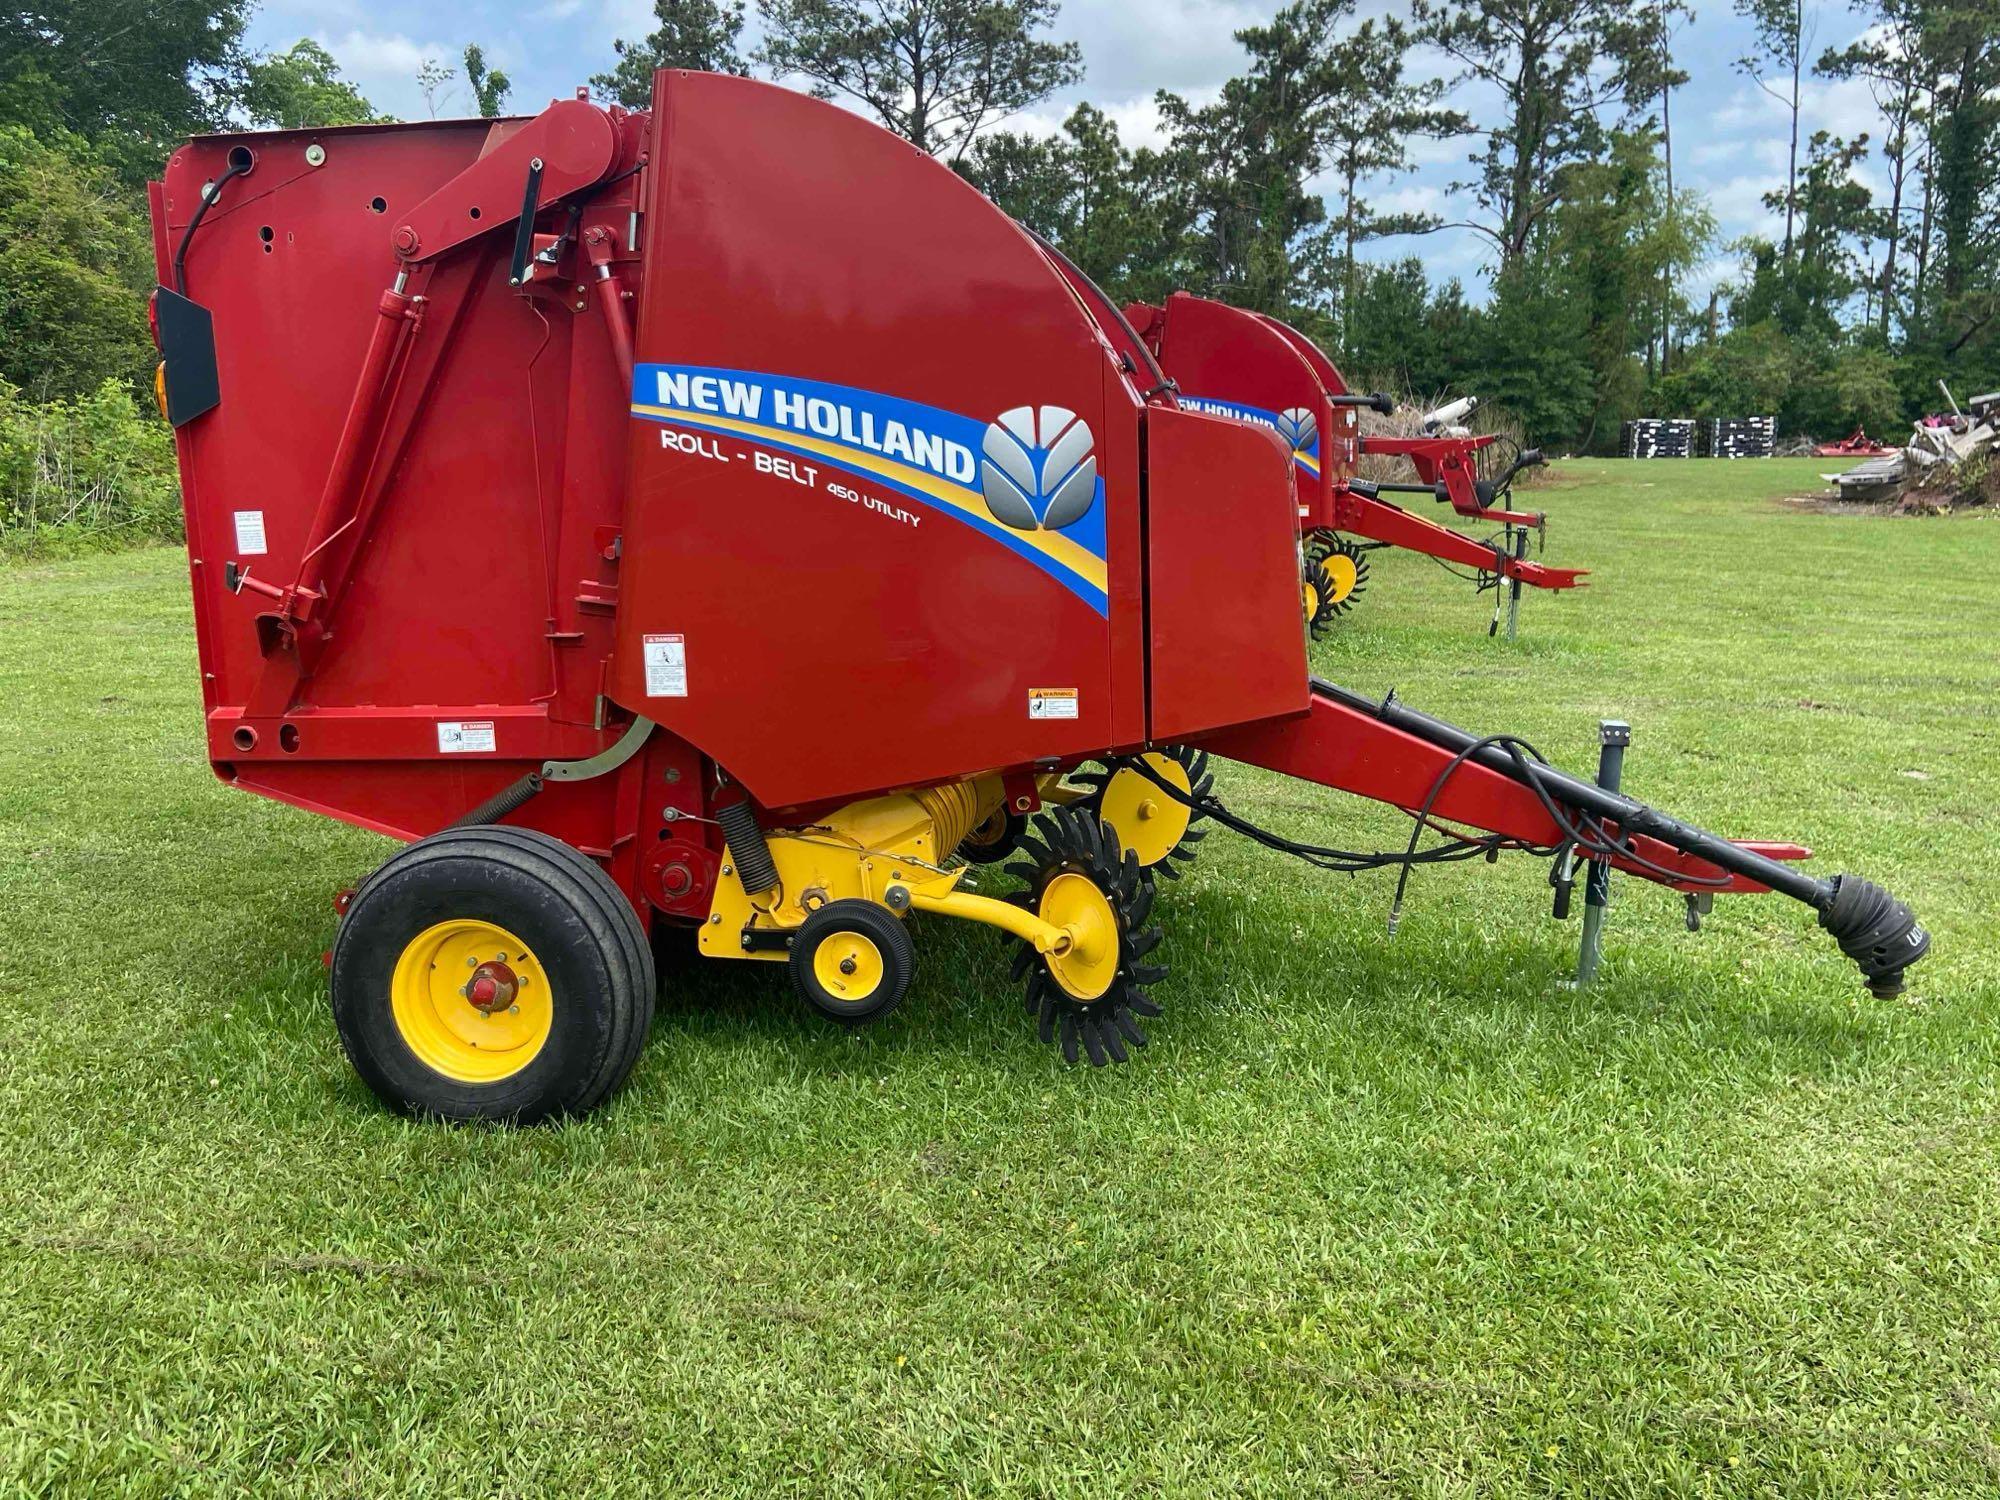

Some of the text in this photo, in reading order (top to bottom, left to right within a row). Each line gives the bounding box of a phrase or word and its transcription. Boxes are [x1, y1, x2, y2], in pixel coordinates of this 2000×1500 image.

[656, 370, 977, 485] NEW HOLLAND
[660, 429, 729, 463] ROLL
[755, 451, 818, 488] BELT
[827, 482, 859, 504] 450
[864, 497, 921, 529] UTILITY
